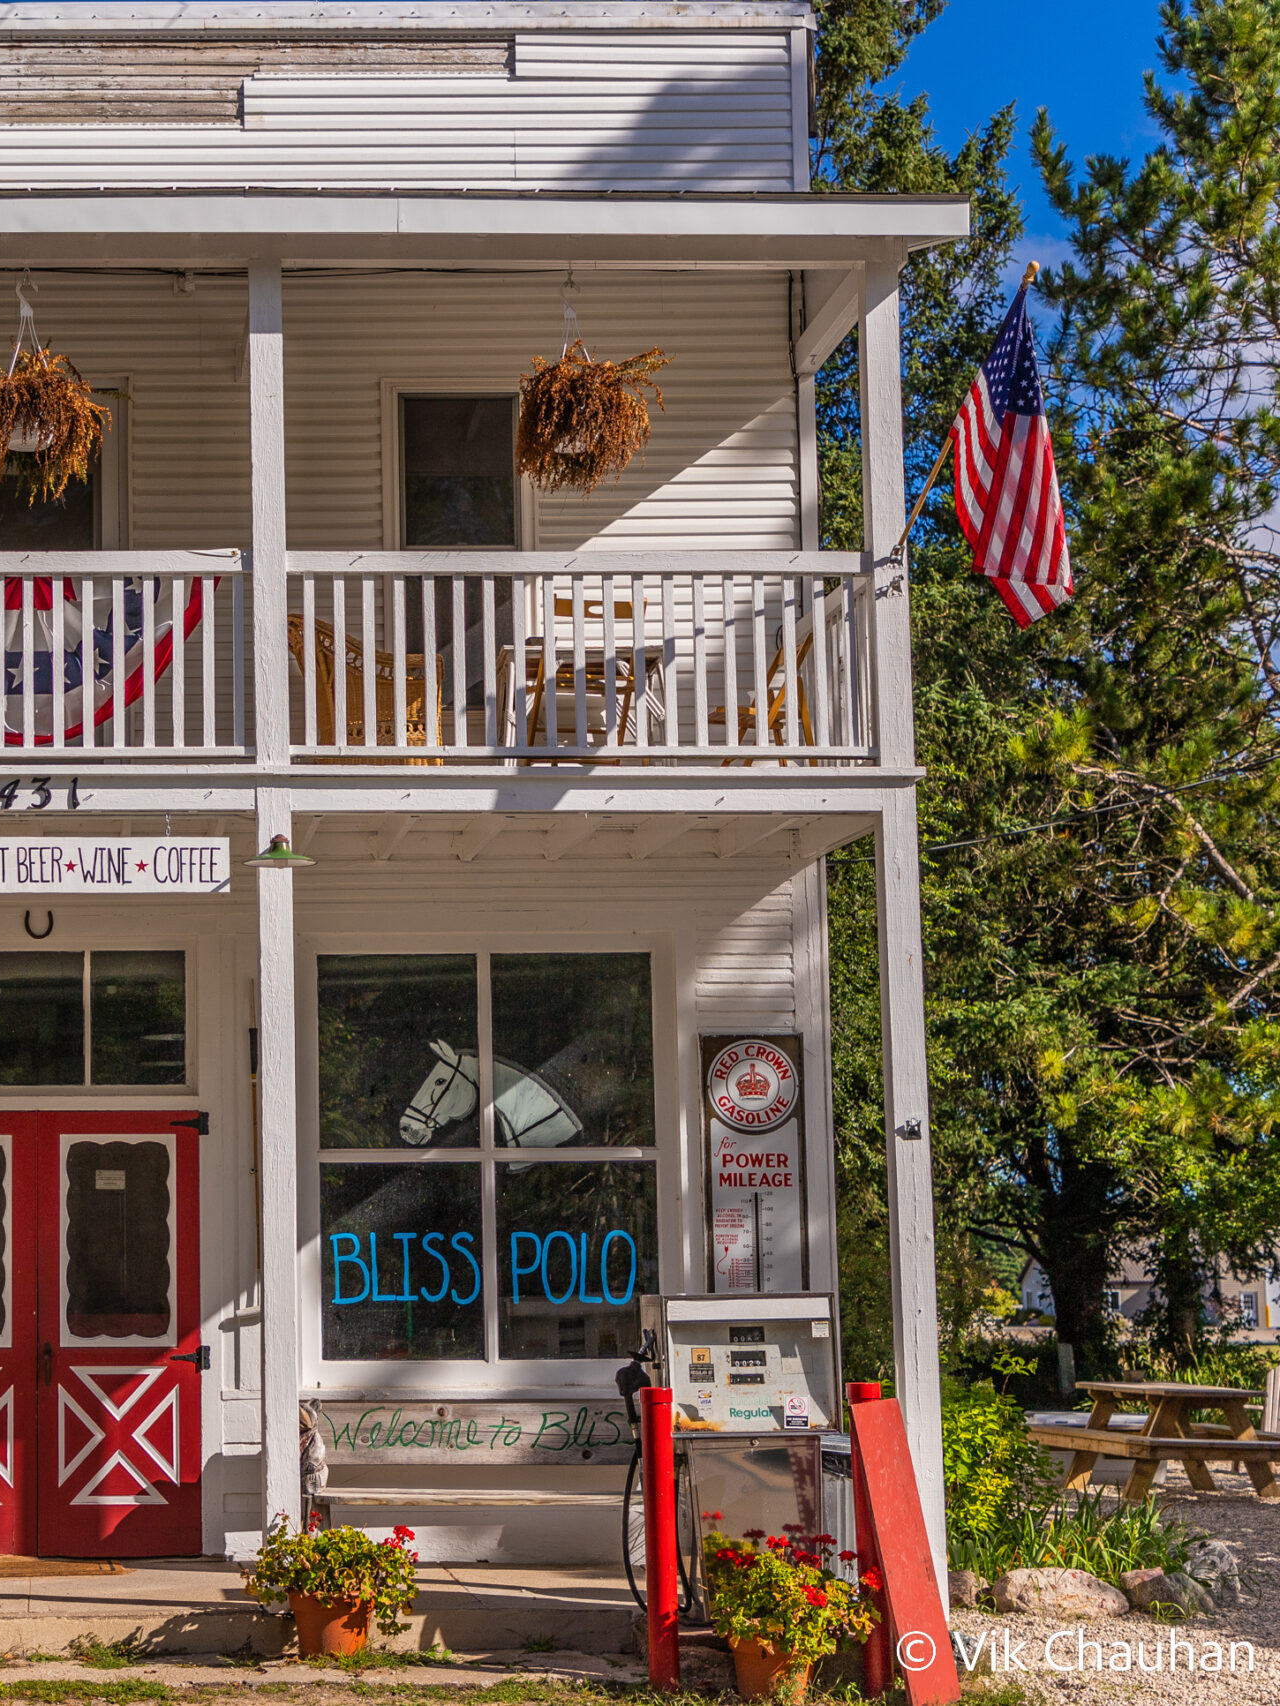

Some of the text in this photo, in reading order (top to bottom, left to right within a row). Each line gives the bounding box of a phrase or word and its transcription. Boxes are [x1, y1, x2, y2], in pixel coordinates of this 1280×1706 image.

[16, 846, 63, 884] BEER
[77, 847, 133, 885] WINE
[153, 845, 221, 884] COFFEE
[713, 1045, 792, 1081] RED CROWN
[717, 1095, 790, 1125] GASOLINE
[713, 1136, 737, 1158] for
[722, 1153, 789, 1168] POWER
[719, 1172, 793, 1187] MILEAGE
[329, 1230, 637, 1305] BLISS POLO
[696, 1354, 706, 1362] 87
[729, 1407, 773, 1420] Regular
[321, 1405, 636, 1452] Welcome to Blis
